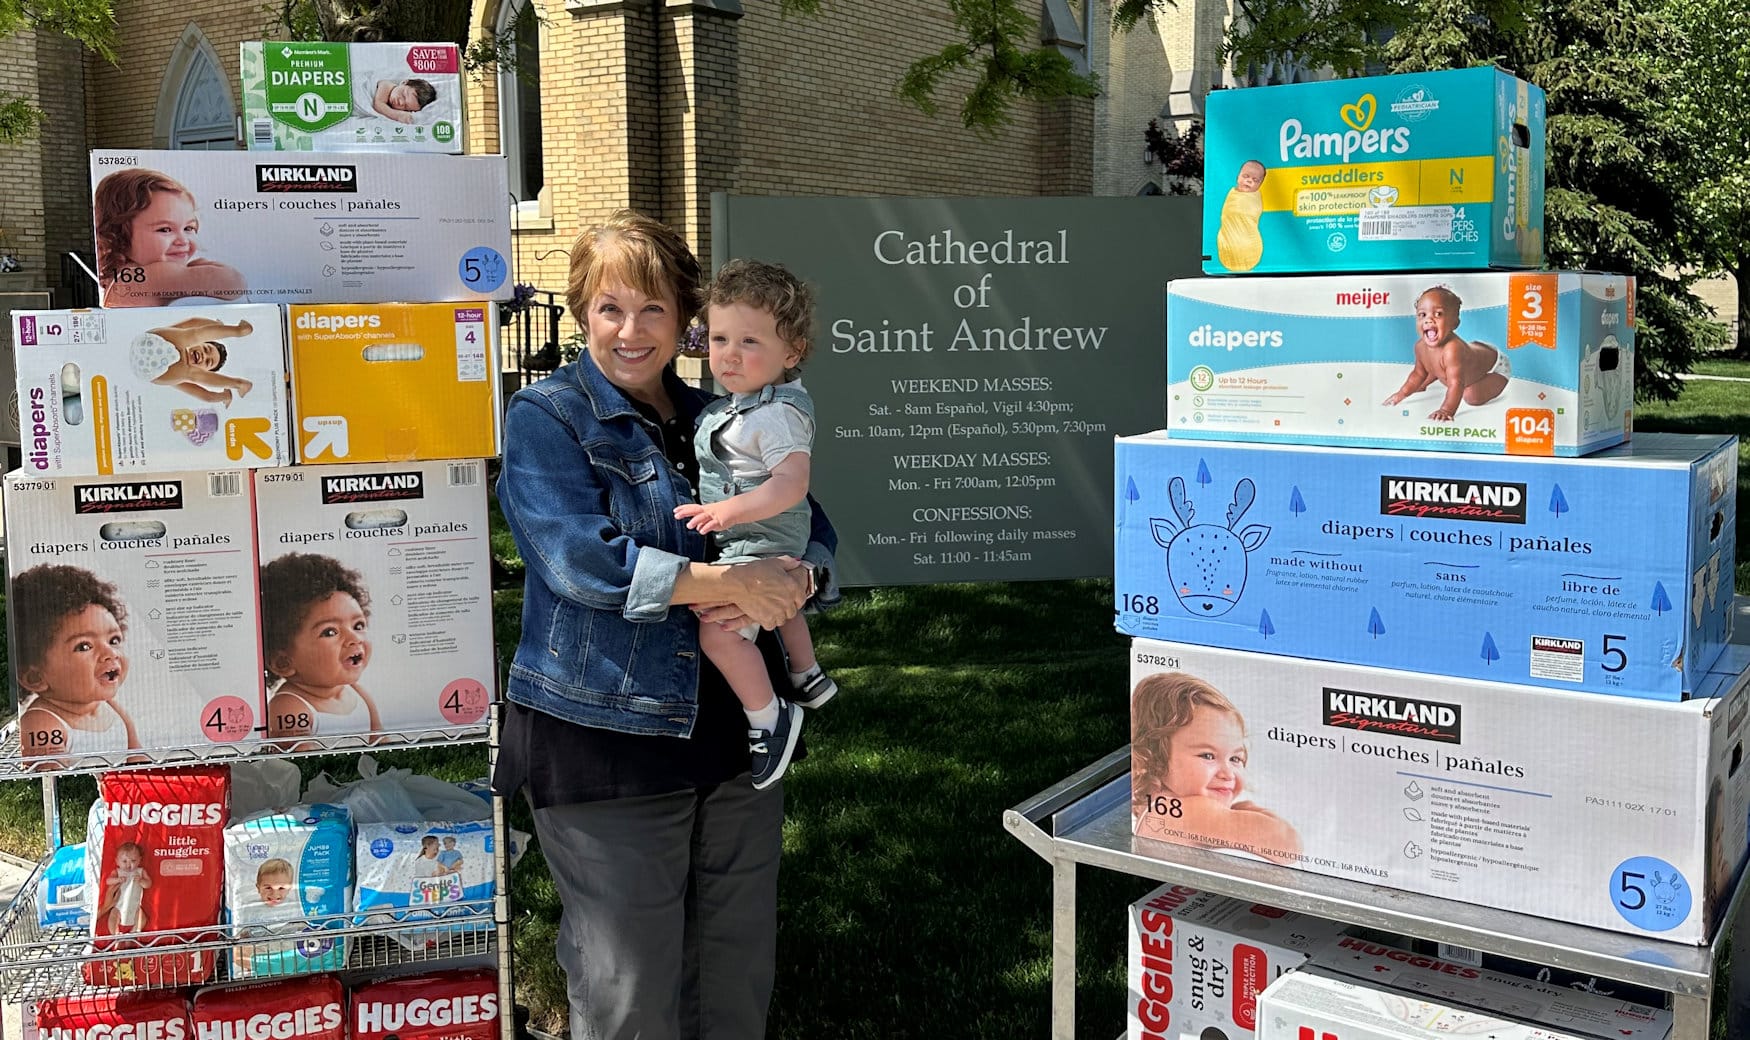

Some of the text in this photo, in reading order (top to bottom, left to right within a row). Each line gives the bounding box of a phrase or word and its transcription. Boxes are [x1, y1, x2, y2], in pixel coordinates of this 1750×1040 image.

[413, 49, 437, 60] SAVE
[291, 60, 324, 68] PREMIUM
[414, 60, 436, 70] $800
[272, 71, 345, 85] DIAPERS
[304, 98, 318, 116] N
[1279, 118, 1410, 163] Pampers
[99, 157, 125, 168] 53782
[262, 167, 353, 182] KIRKLAND
[1301, 168, 1384, 185] swaddlers
[1450, 168, 1464, 185] N
[214, 197, 401, 212] diapers couches pañales
[1310, 192, 1332, 201] 100%
[1299, 202, 1316, 211] skin
[1319, 201, 1366, 212] protection
[875, 230, 1070, 264] Cathedral
[112, 268, 146, 283] 168
[465, 258, 481, 282] 5
[954, 274, 992, 308] of
[1336, 288, 1389, 309] meijer
[1522, 292, 1542, 318] 3
[47, 324, 61, 336] 5
[296, 312, 381, 331] diapers
[465, 331, 476, 344] 4
[832, 316, 1108, 353] Saint Andrew
[1188, 324, 1283, 351] diapers
[892, 377, 1053, 394] WEEKEND MASSES:
[869, 401, 1073, 416] Sat. 8am Español, Vigil 4:30pm;
[29, 387, 50, 470] diapers
[835, 421, 1106, 439] Sun. 10am, 12pm (Español), 5:30pm, 7:30pm
[1420, 426, 1496, 438] SUPER PACK
[1509, 416, 1550, 435] 104
[1515, 436, 1543, 444] diapers
[54, 454, 62, 470] with
[893, 453, 1051, 469] WEEKDAY MASSES:
[264, 473, 291, 482] 53779
[327, 474, 420, 493] KIRKLAND
[889, 476, 1056, 490] Mon. Fri 7:00am, 12:05pm
[14, 483, 42, 491] 53779
[80, 484, 179, 503] KIRKLAND
[1389, 480, 1521, 507] KIRKLAND
[81, 501, 180, 513] Signature
[913, 506, 1032, 522] CONFESSIONS:
[1388, 500, 1521, 518] Signature
[280, 522, 468, 544] diapers couches pañales
[910, 529, 1076, 545] Fri following daily masses
[1322, 520, 1592, 555] diapers couches pañales
[30, 534, 230, 556] diapers couches pañales
[914, 550, 1031, 564] Sat. 11:00 11:45am
[1270, 556, 1363, 574] made without
[1321, 572, 1368, 585] natural rubber
[1436, 571, 1467, 582] sans
[1275, 578, 1359, 593] latex elemental chlorine
[1444, 585, 1513, 598] latex caoutchouc
[1562, 581, 1620, 596] libre de
[1123, 594, 1159, 615] 168
[1433, 594, 1455, 602] chlore
[1607, 599, 1637, 609] látex de
[1532, 604, 1650, 621] caucho cloro elemental
[1534, 637, 1581, 650] KIRKLAND
[1137, 654, 1166, 666] 53782
[1601, 633, 1627, 672] 5
[444, 689, 463, 713] 4
[1330, 692, 1456, 730] KIRKLAND
[206, 708, 226, 732] 4
[277, 713, 310, 730] 198
[1329, 712, 1456, 739] Signature
[28, 729, 64, 746] 198
[1268, 726, 1524, 778] diapers couches pañales
[104, 802, 222, 826] HUGGIES
[1145, 794, 1182, 818] 168
[1455, 828, 1478, 837] plantes
[1464, 823, 1482, 831] partir
[1501, 822, 1530, 831] materials
[169, 836, 197, 846] little
[1431, 831, 1523, 851] fabricado base
[1439, 839, 1461, 847] plantas
[154, 847, 210, 861] snugglers
[1188, 833, 1388, 878] 168 DIAPERS 168 COUCHES 168 PAÑALES
[413, 885, 460, 903] STEPS
[419, 879, 453, 893] Gentle
[1620, 871, 1646, 910] 5
[1338, 937, 1481, 979] HUGGIES
[1188, 934, 1208, 1011] snug &
[1207, 958, 1228, 998] dry
[1485, 975, 1562, 997] snug dry
[198, 1003, 341, 1040] HUGGIES
[358, 993, 498, 1033] HUGGIES
